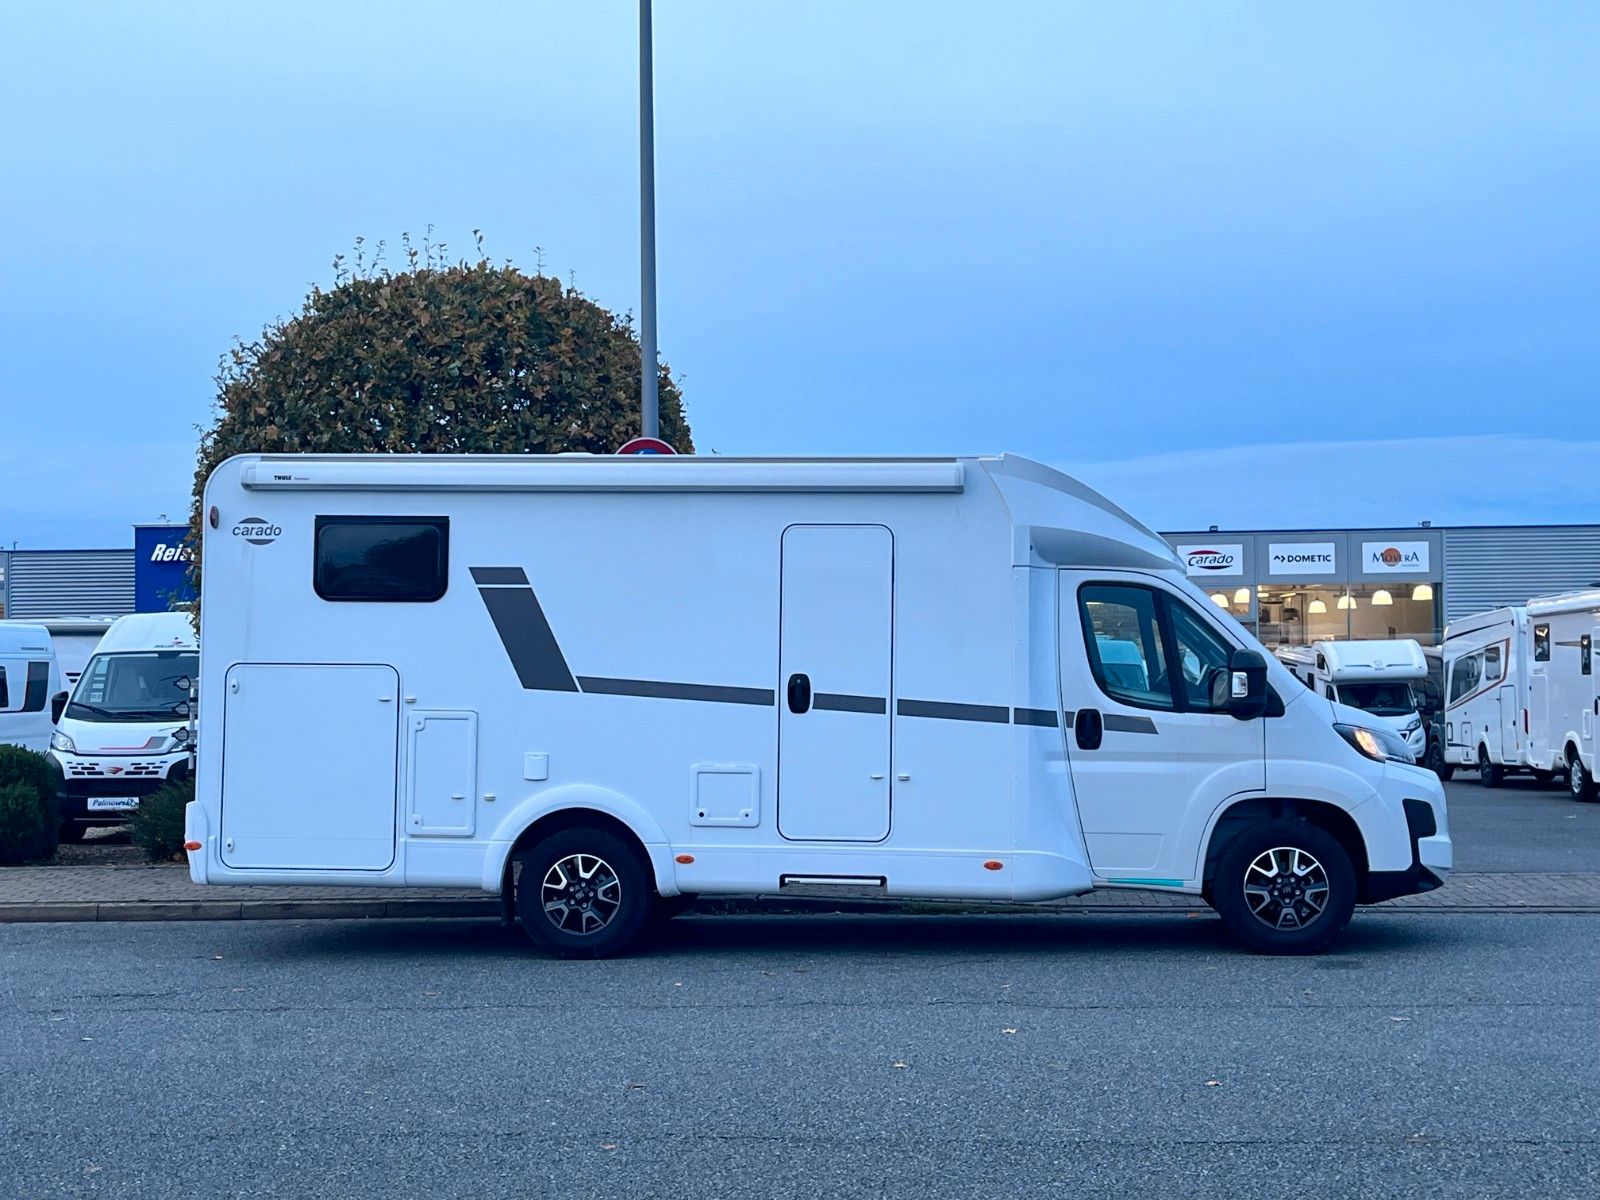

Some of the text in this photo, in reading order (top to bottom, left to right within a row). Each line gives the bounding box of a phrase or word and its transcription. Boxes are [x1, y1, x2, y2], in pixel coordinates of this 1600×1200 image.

[232, 524, 282, 536] carado
[1188, 554, 1234, 567] carado
[1287, 554, 1332, 563] DOMETIC
